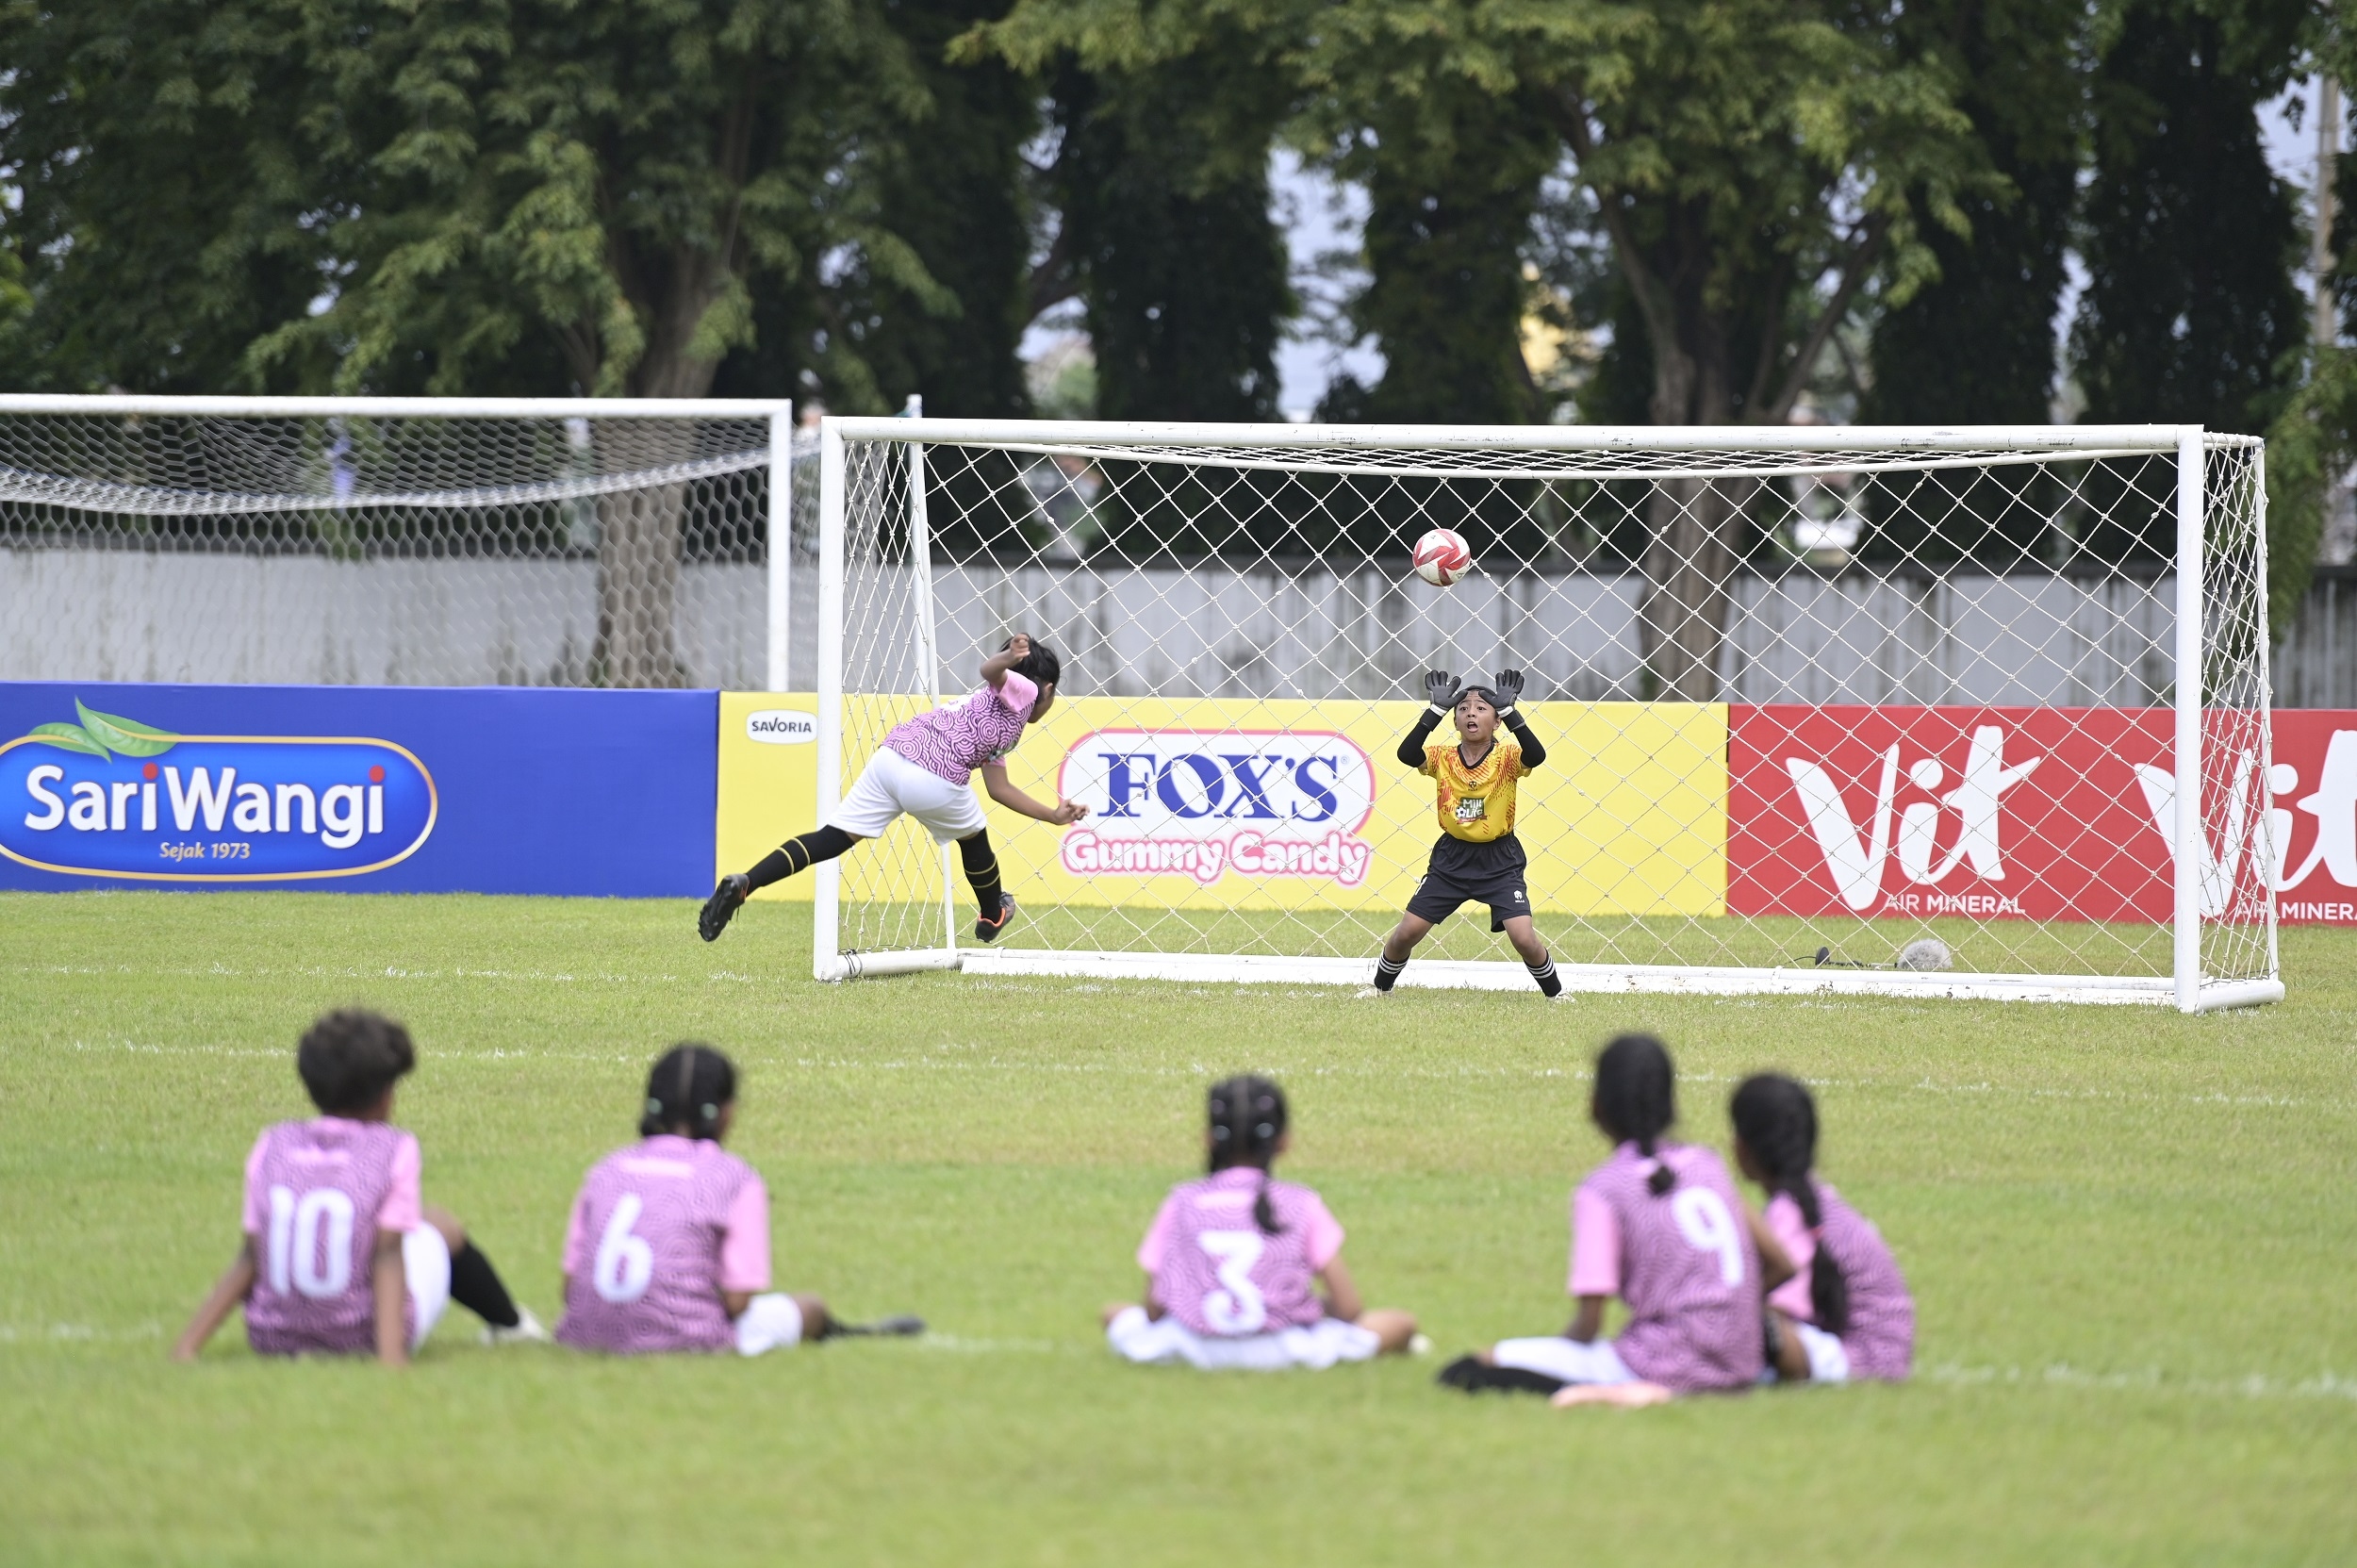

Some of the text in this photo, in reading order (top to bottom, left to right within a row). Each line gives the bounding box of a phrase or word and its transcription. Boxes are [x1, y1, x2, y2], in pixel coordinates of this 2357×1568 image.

[751, 717, 813, 733] SAVORIA
[25, 762, 385, 849] SariWangi
[1097, 753, 1338, 822] FOX'S
[1785, 724, 2041, 911] Vit
[159, 841, 251, 863] Sejak 1973
[1063, 830, 1226, 883] Gummy
[1229, 830, 1374, 885] Candy
[1885, 894, 2026, 914] AIR MINERAL
[2282, 901, 2357, 920] MINER
[270, 1184, 355, 1298] 10
[594, 1193, 654, 1304] 6
[1673, 1185, 1744, 1289] 9
[1196, 1230, 1266, 1333] 3
